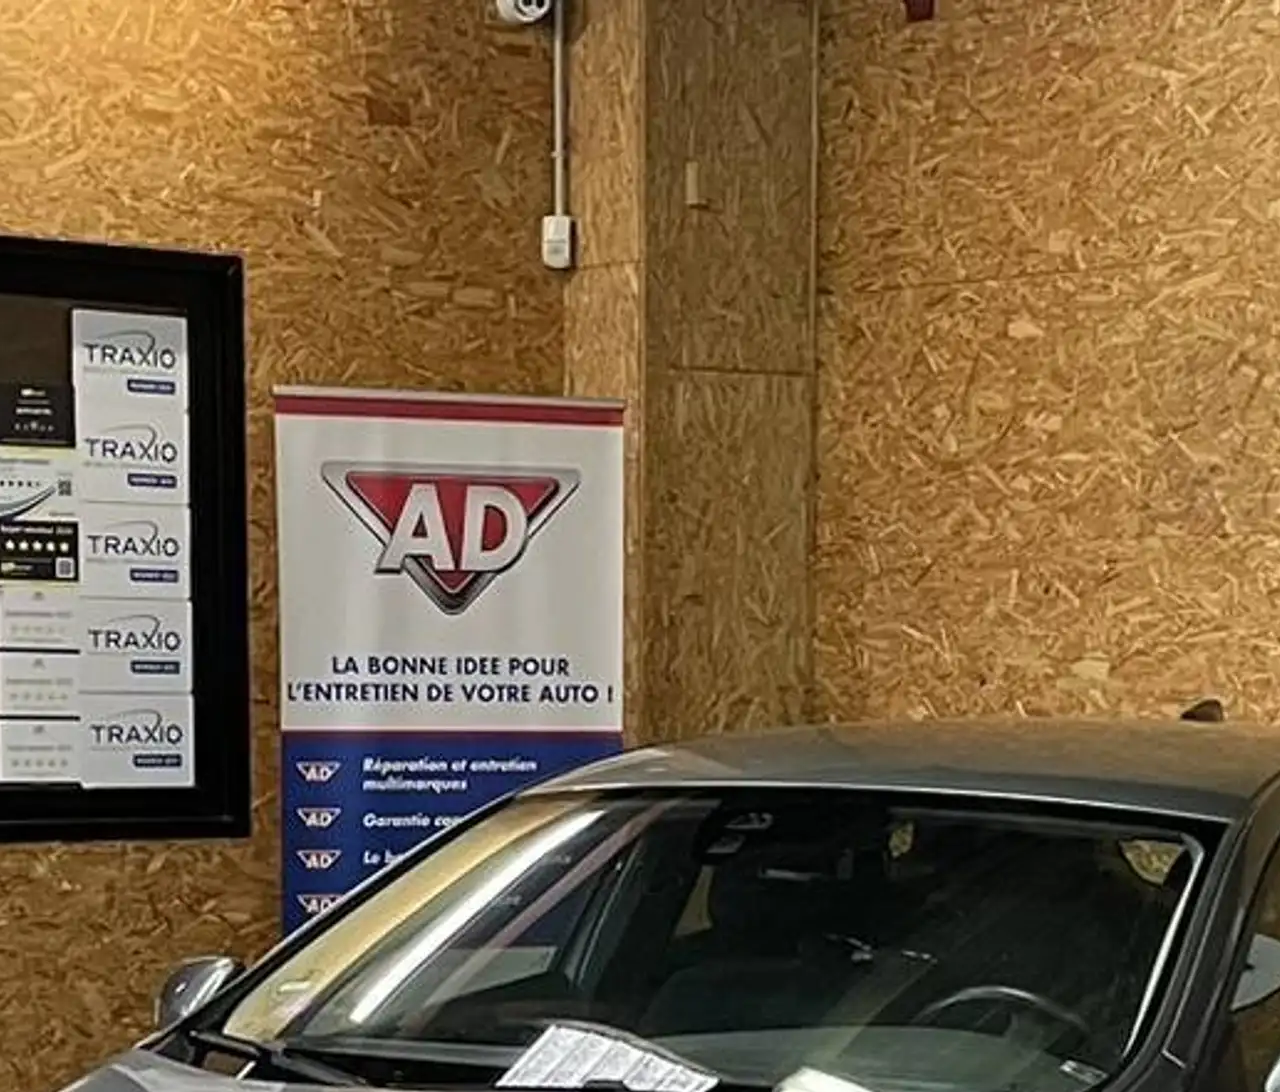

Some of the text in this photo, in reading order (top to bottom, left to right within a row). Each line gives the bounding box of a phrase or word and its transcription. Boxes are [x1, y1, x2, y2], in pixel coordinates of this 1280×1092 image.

[82, 341, 177, 369] TRAXIO
[84, 437, 178, 463] TRAXIO
[376, 483, 530, 575] AD
[86, 534, 181, 557] TRAXIO
[88, 628, 182, 651] TRAXIO
[332, 656, 570, 677] LA BONNE IDEE POUR
[287, 683, 418, 702] L'ENTRETIEN
[426, 684, 454, 702] DE
[462, 684, 531, 703] VOTRE
[539, 684, 599, 703] AUTO
[89, 723, 183, 745] TRAXIO
[363, 756, 538, 775] Réparation et entretien
[362, 775, 468, 793] multimarques
[362, 812, 431, 827] Garantie
[363, 850, 381, 864] Le
